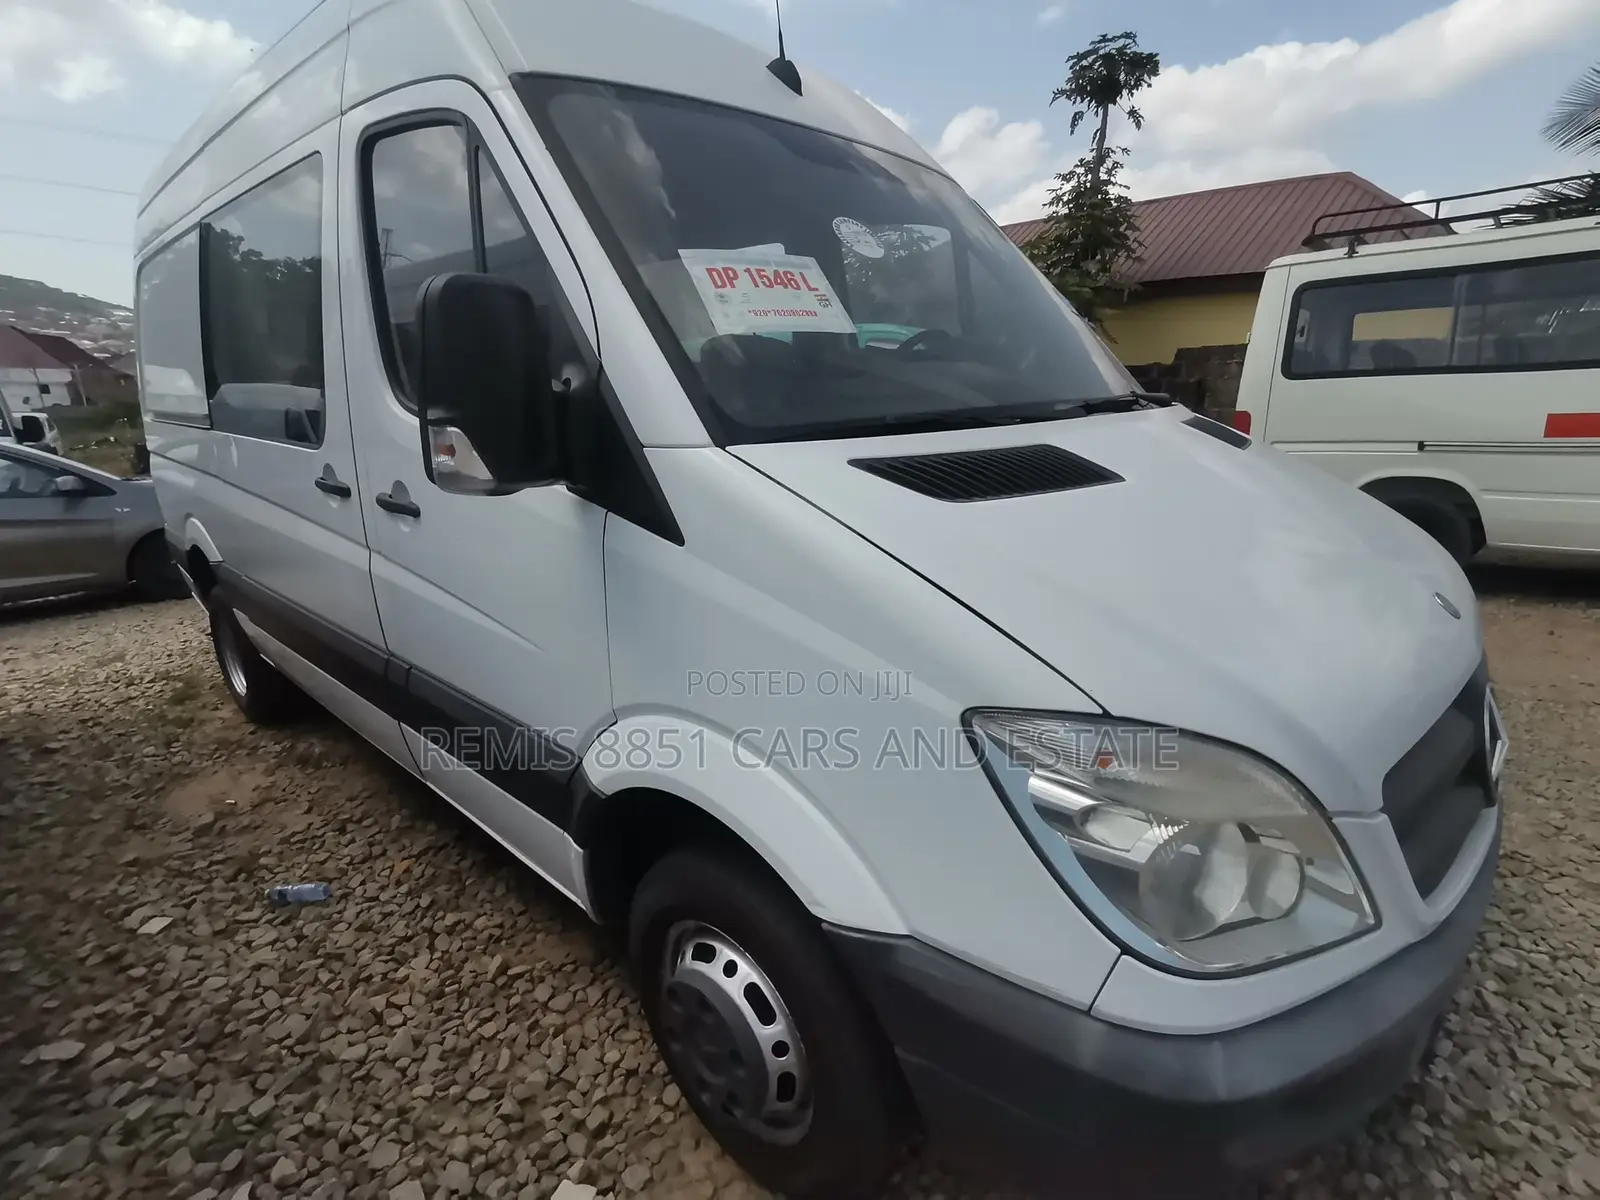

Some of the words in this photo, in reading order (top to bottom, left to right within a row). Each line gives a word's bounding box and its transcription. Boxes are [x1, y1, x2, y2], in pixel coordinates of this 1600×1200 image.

[705, 266, 740, 289] DP
[743, 267, 801, 290] 1546
[799, 271, 819, 291] L
